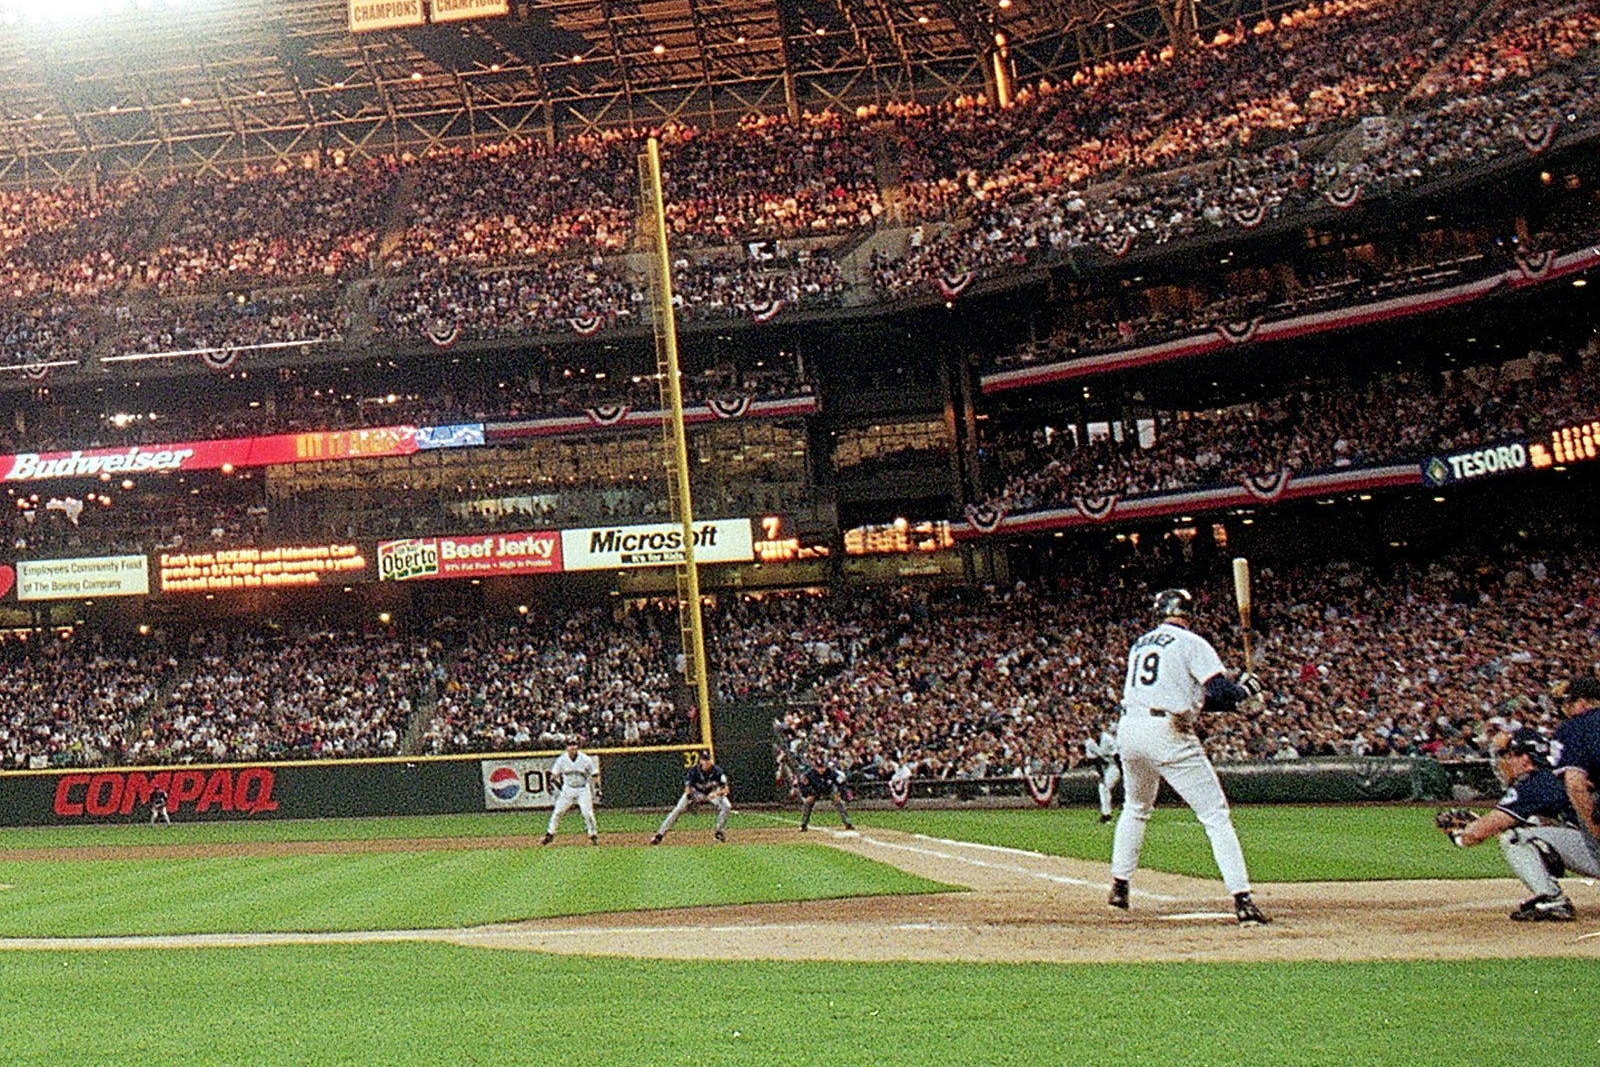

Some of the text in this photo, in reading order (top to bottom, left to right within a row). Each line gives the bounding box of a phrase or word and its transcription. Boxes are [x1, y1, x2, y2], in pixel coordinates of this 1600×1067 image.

[354, 0, 418, 22] CHAMPIONS
[5, 447, 192, 480] Budweiser
[1448, 444, 1526, 479] TESORO
[763, 517, 780, 540] 7
[216, 549, 259, 562] BOEING
[441, 538, 493, 560] Beef
[496, 535, 554, 558] Jerky
[23, 560, 142, 576] Employees Community Fund
[382, 547, 436, 575] Oberto
[35, 581, 49, 591] The
[52, 579, 81, 592] Boeing
[82, 578, 121, 591] Company
[1131, 652, 1160, 687] 19
[54, 768, 278, 816] COMPAQ
